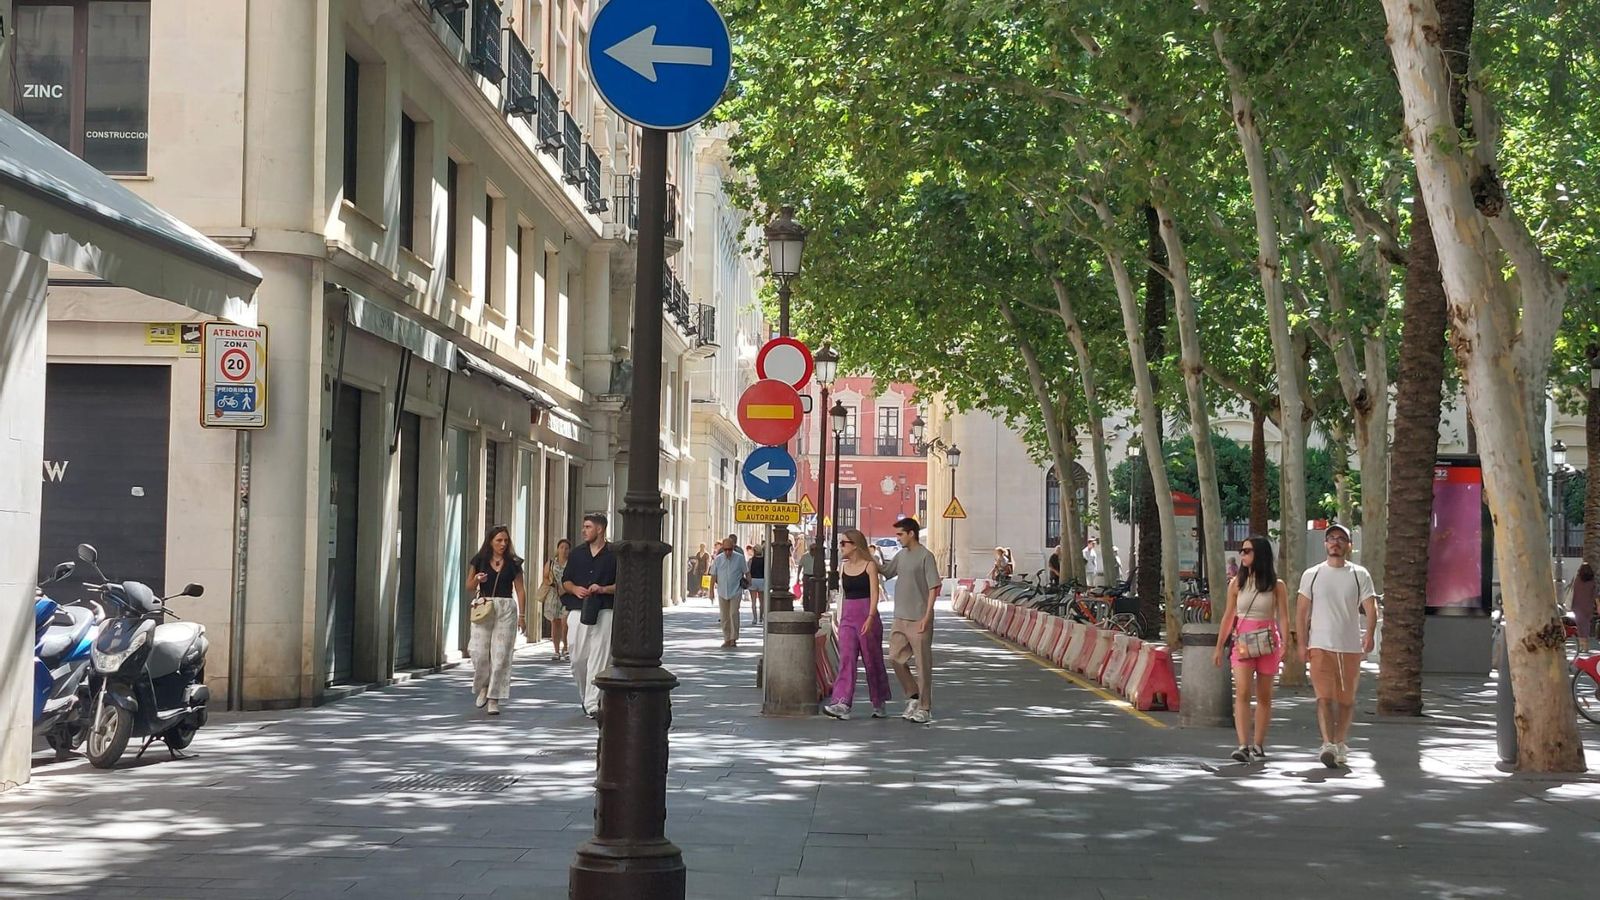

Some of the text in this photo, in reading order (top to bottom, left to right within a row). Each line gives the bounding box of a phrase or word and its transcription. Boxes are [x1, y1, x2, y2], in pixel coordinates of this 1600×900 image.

[23, 84, 63, 98] ZINC
[227, 359, 244, 370] 20
[738, 505, 799, 514] EXCEPTO GARAJE
[746, 514, 790, 522] AUTORIZADO
